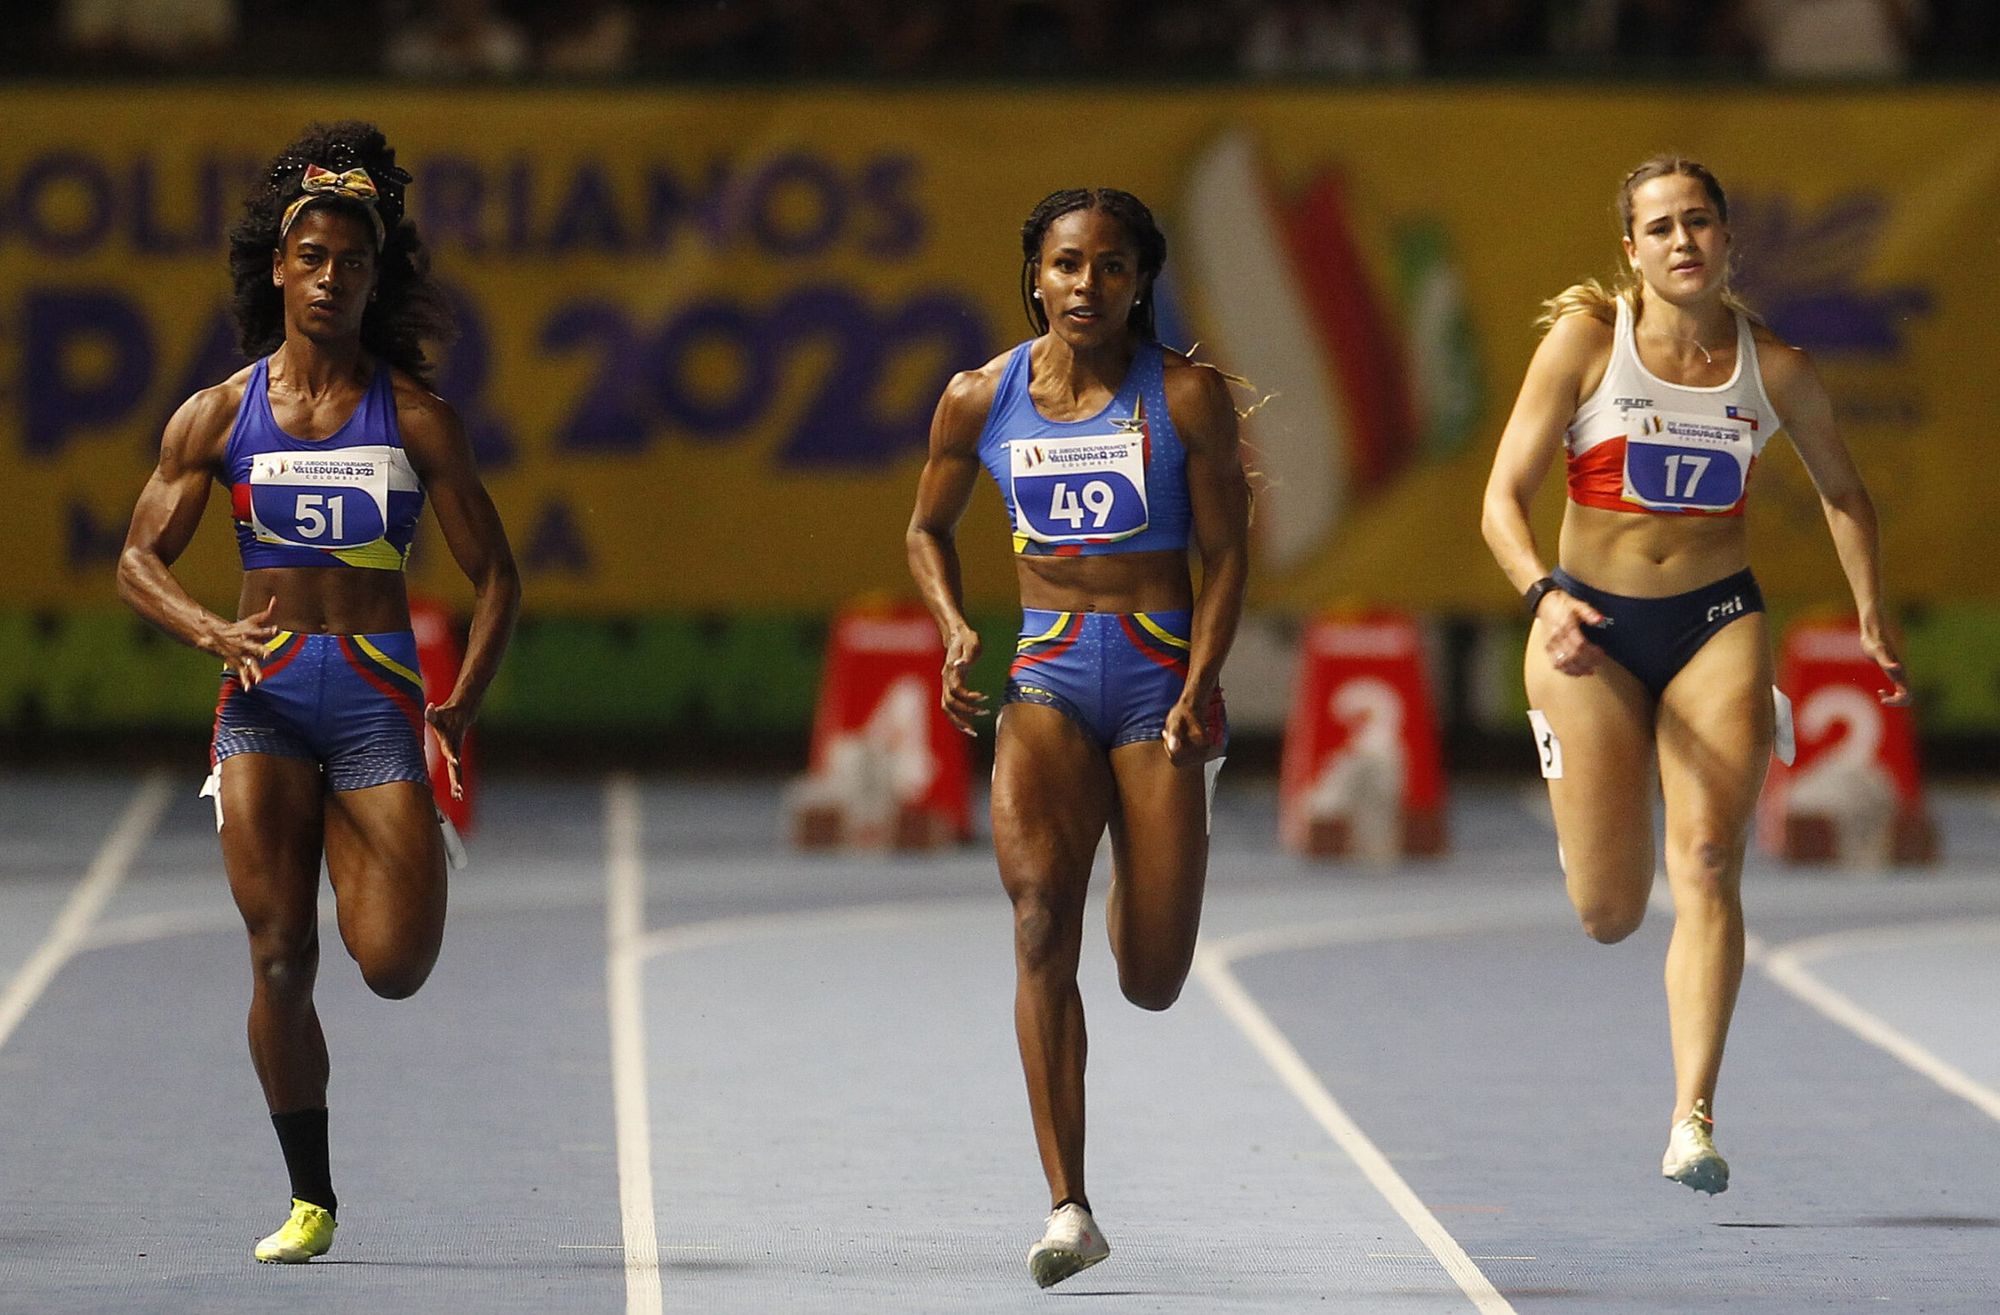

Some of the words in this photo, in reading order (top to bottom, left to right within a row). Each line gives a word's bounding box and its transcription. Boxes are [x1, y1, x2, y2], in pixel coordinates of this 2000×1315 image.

[538, 280, 988, 472] 2022
[293, 466, 354, 476] VALLEDUPAR
[355, 468, 375, 476] 2022
[330, 460, 374, 468] BOLIVARIANOS
[1048, 451, 1108, 463] VALLEDUPAR
[1109, 450, 1129, 459] 2022
[1664, 453, 1712, 499] 17
[295, 494, 344, 540] 51
[1048, 480, 1115, 529] 49
[1787, 684, 1888, 812] 2
